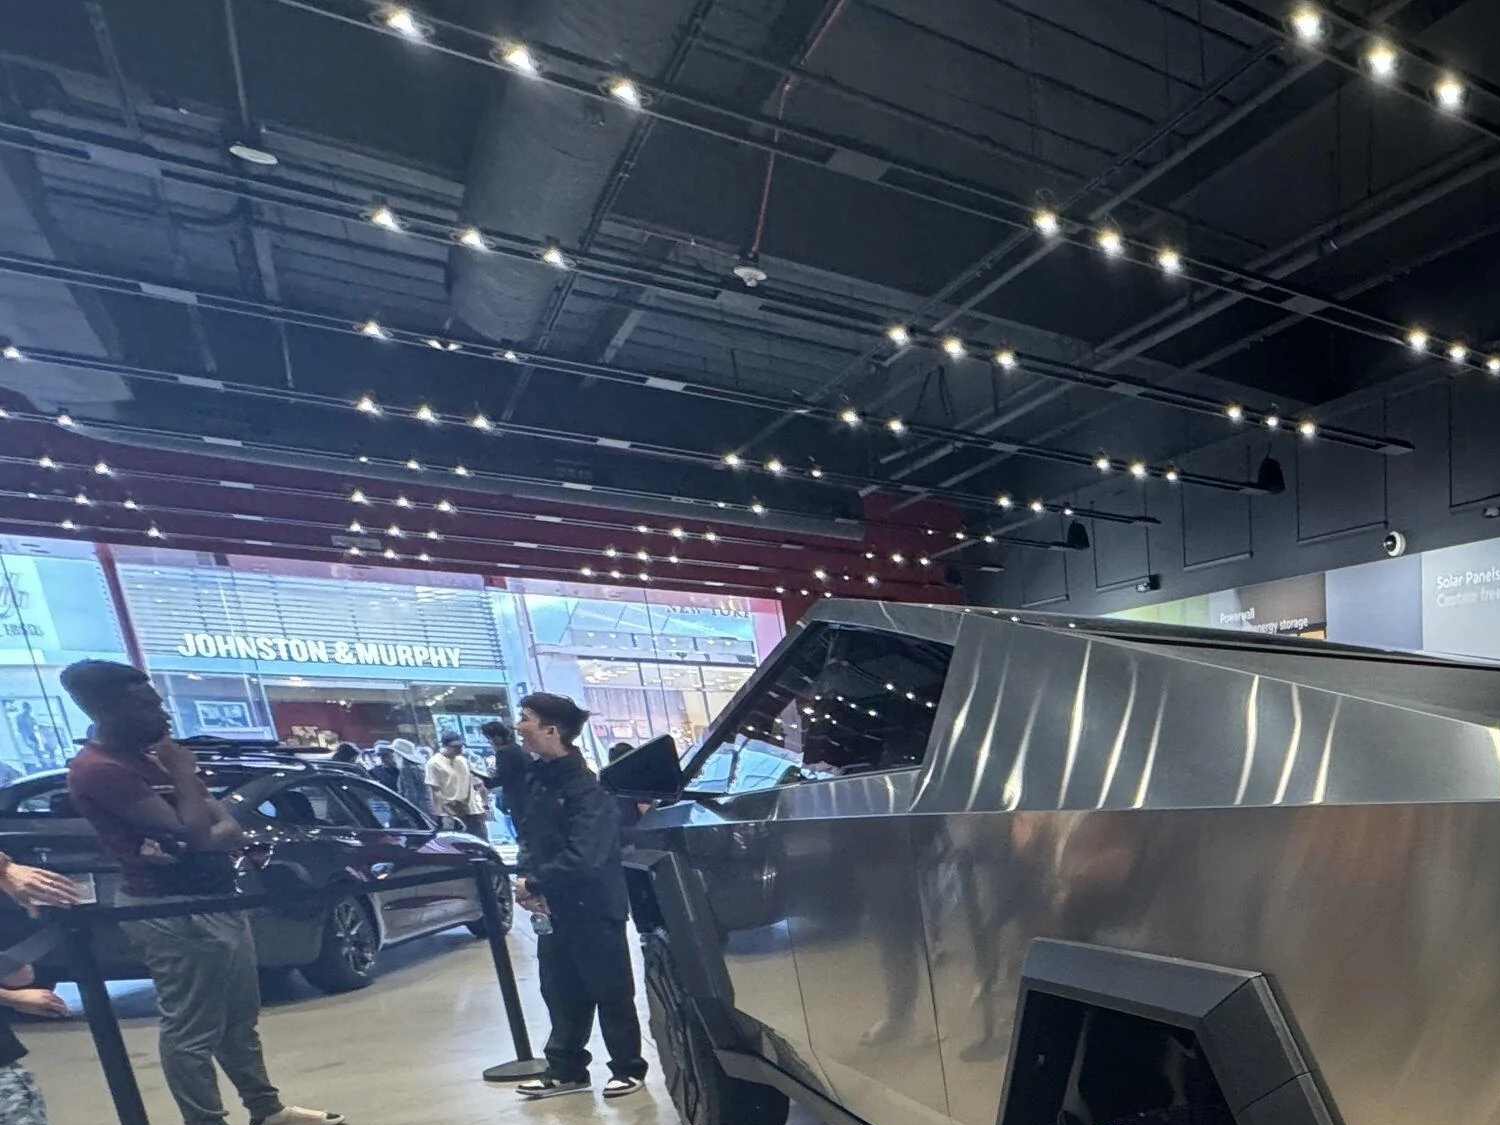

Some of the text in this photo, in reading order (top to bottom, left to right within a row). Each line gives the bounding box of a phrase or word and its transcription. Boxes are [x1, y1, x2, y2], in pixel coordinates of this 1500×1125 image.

[1436, 567, 1500, 589] Solar Panels
[1279, 617, 1309, 630] storage
[177, 633, 461, 668] JOHNSTON & MURPHY
